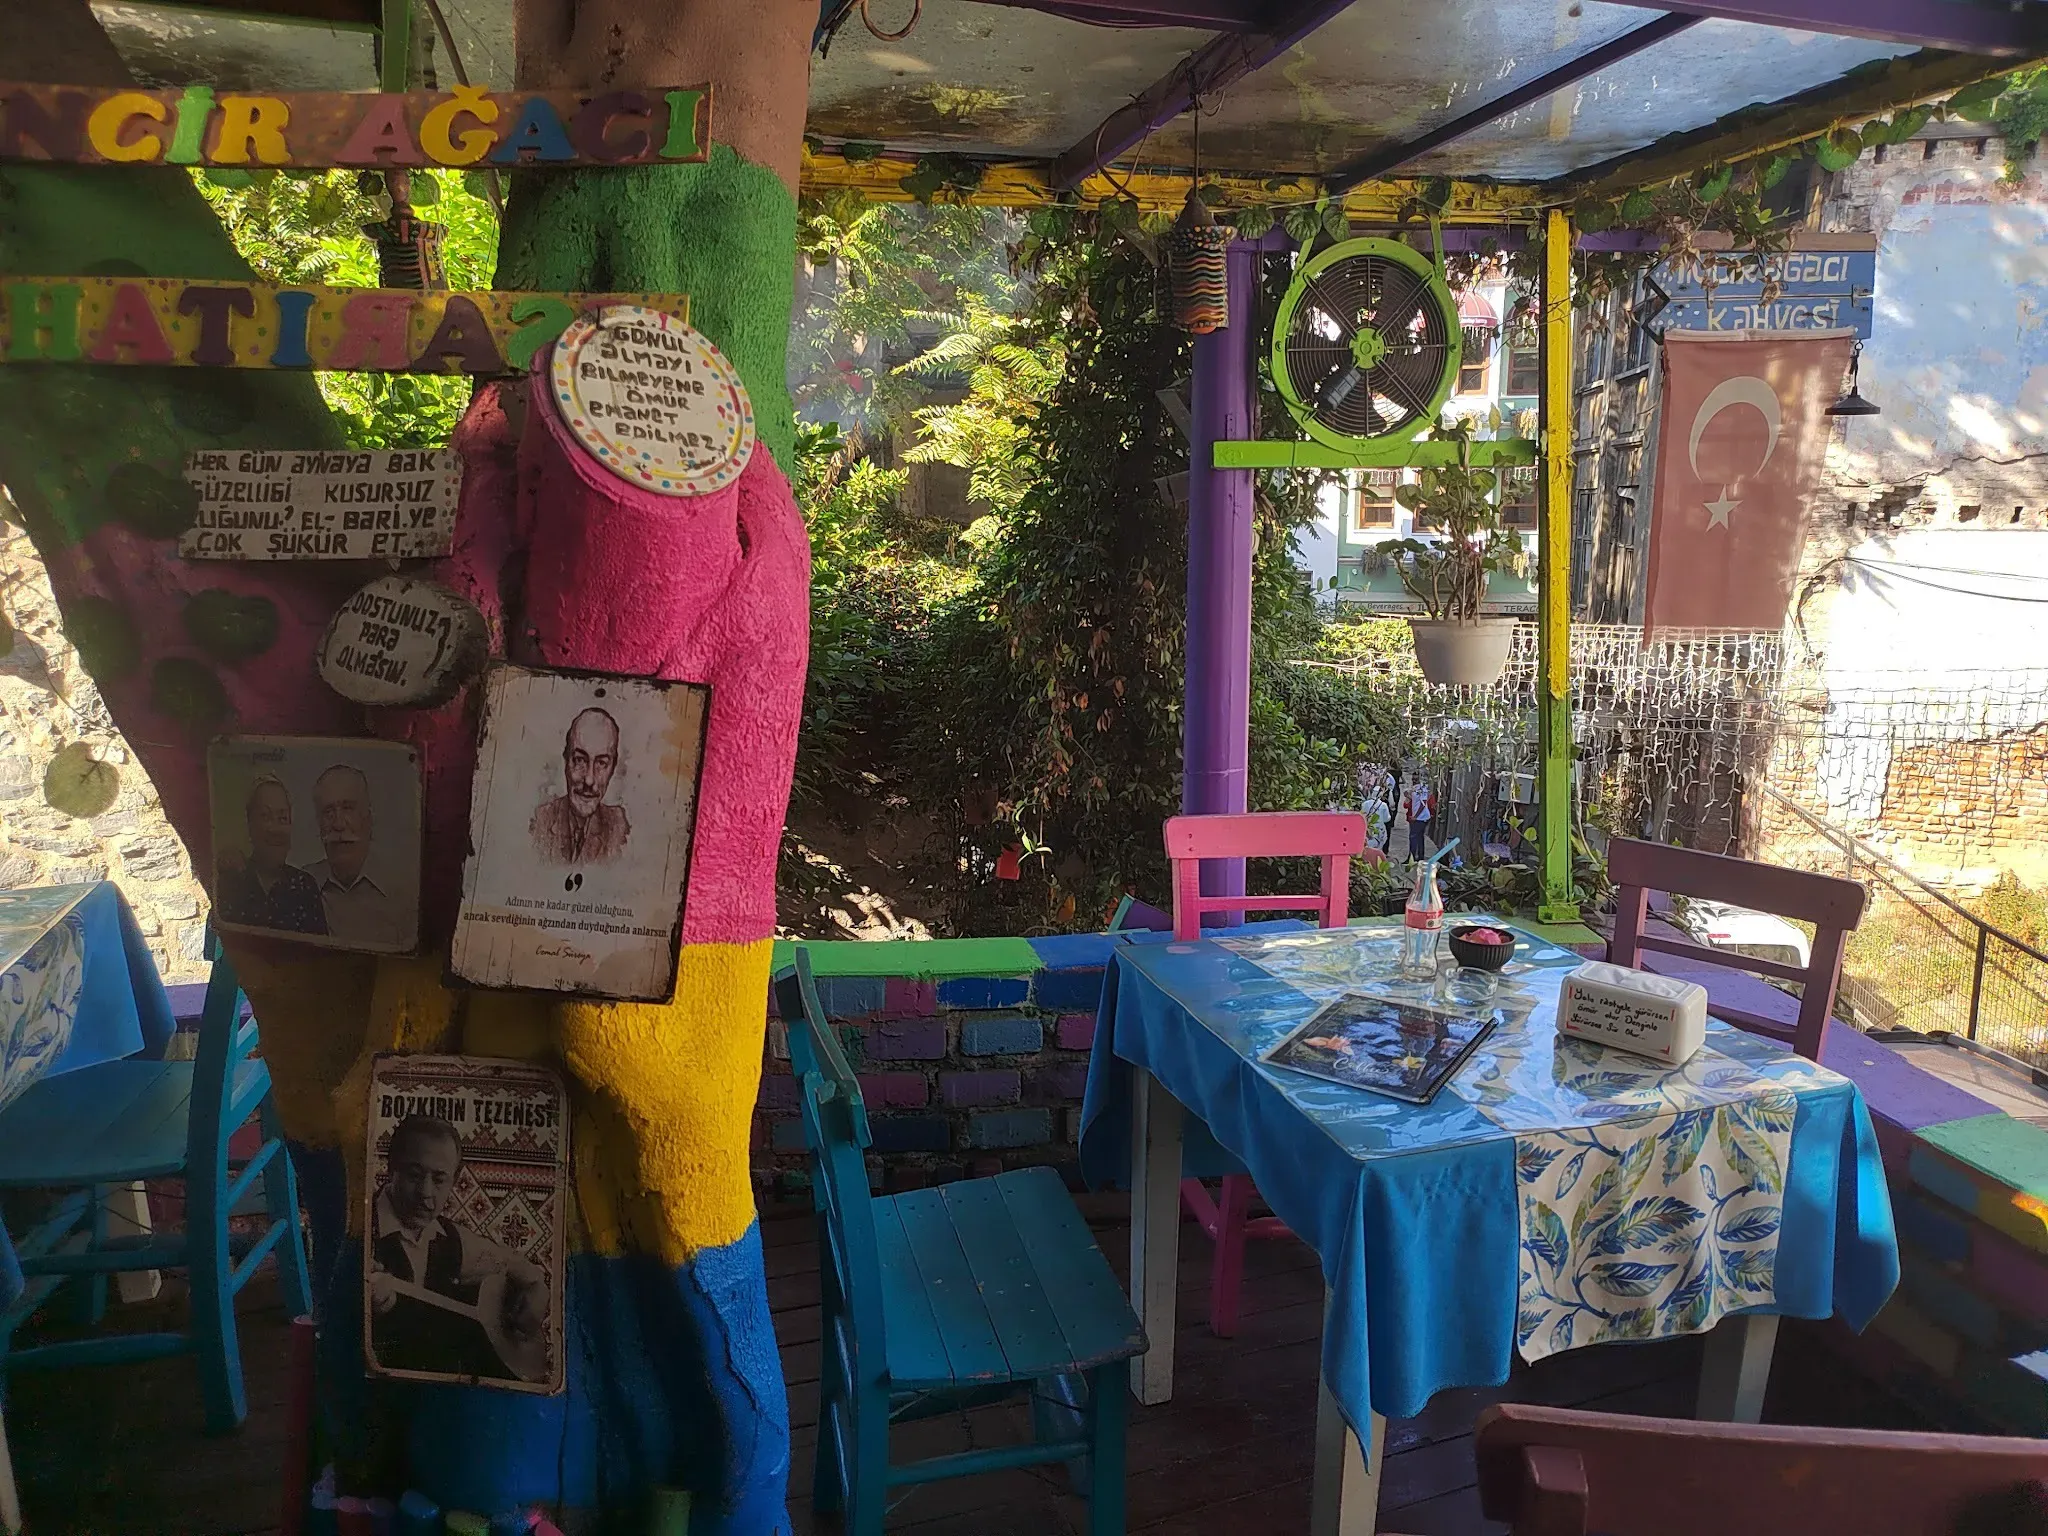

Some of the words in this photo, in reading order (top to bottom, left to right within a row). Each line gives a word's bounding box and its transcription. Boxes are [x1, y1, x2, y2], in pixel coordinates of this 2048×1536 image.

[335, 84, 706, 166] AĞACI
[239, 450, 282, 474] GÜN
[324, 480, 435, 503] KUSURSUZ
[197, 531, 242, 556] ÇOK
[266, 527, 348, 559] ŞÜKÜR
[351, 592, 439, 637] DOSTUNUZ
[1367, 602, 1403, 612] Beverages
[505, 896, 533, 909] Adının
[534, 899, 545, 909] ne
[546, 899, 570, 912] kadar
[571, 901, 593, 915] güzel
[463, 910, 490, 922] ancak
[491, 913, 536, 928] sevdiğinin
[537, 917, 576, 931] ağzından
[578, 920, 630, 935] duyduğunda
[632, 926, 669, 938] anlarsın.
